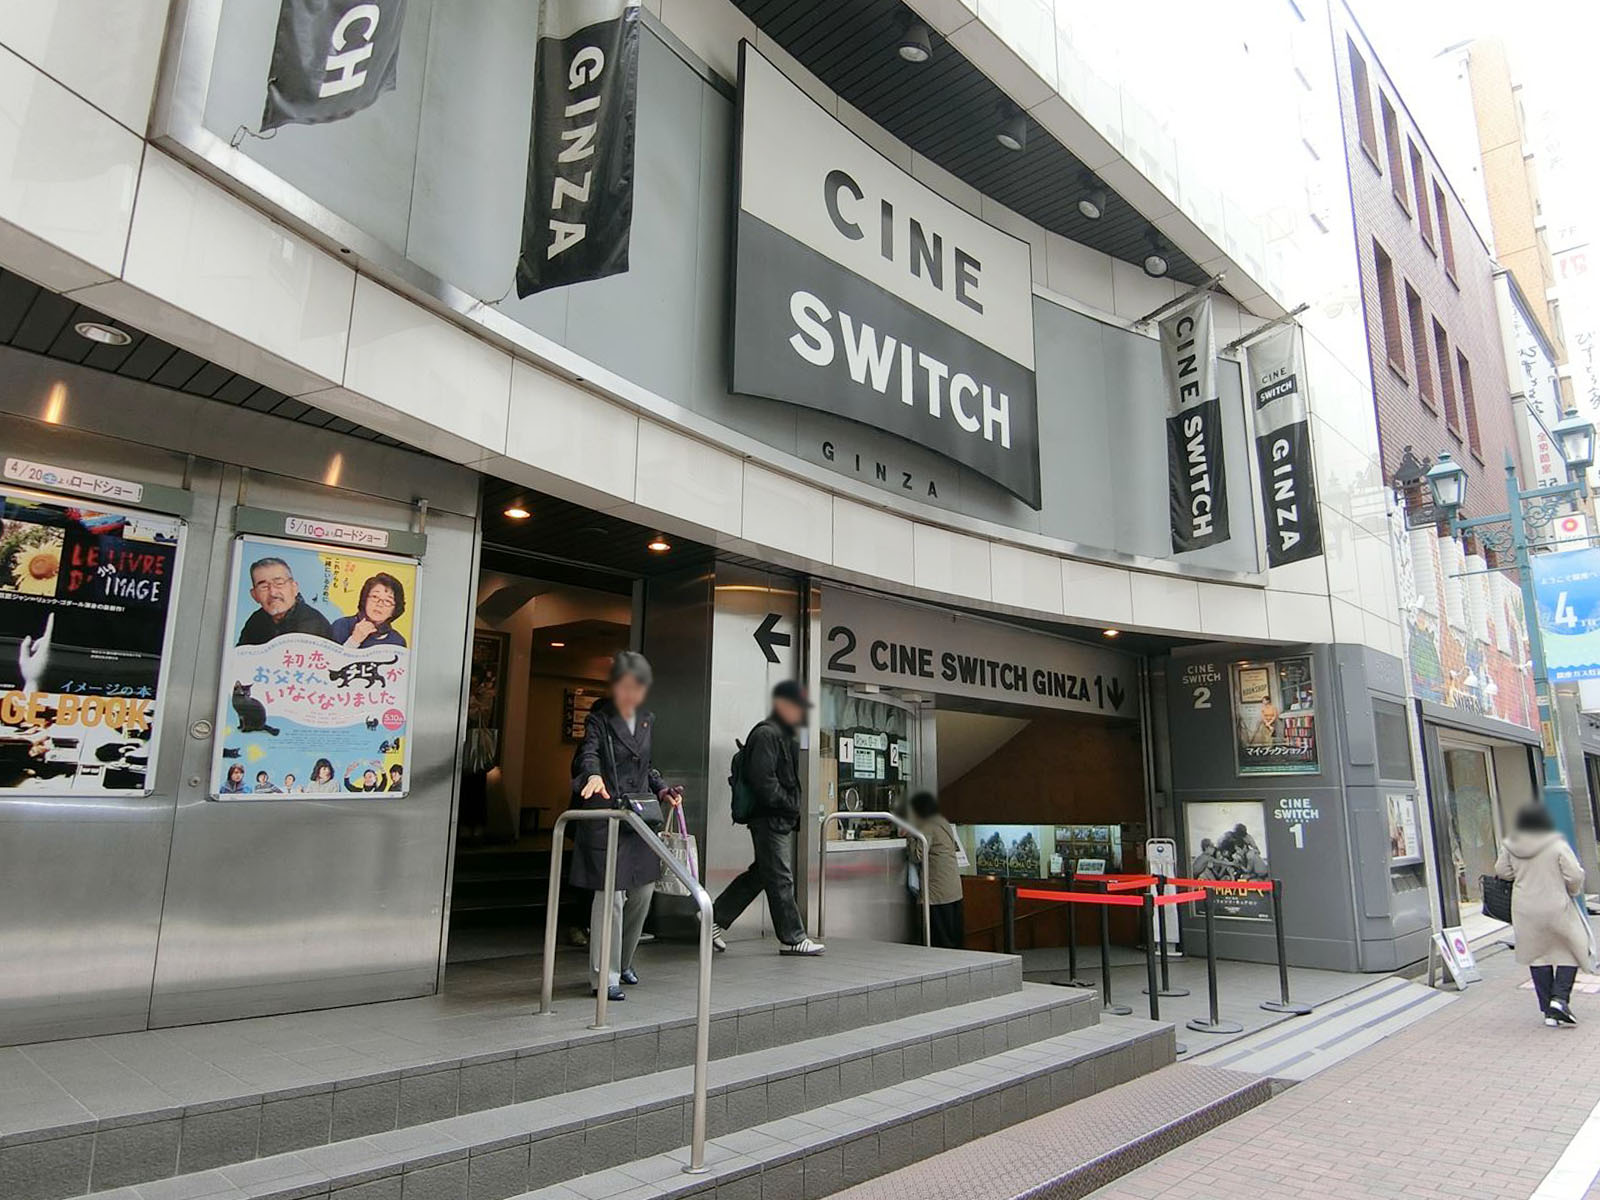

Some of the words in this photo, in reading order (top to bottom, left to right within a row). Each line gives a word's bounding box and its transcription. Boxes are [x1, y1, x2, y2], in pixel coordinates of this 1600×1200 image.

[547, 45, 605, 261] GINZA
[824, 168, 984, 316] CINE
[788, 290, 1011, 450] SWITCH
[1175, 316, 1200, 403] CINE
[1261, 367, 1288, 384] CINE
[1259, 380, 1293, 402] SWITCH
[822, 441, 938, 498] GINZA
[1183, 415, 1214, 539] SWITCH
[1271, 438, 1301, 551] GINZA
[71, 543, 99, 567] LE
[104, 576, 162, 602] IMAGE
[827, 625, 857, 674] 2
[870, 640, 935, 679] CINE
[941, 652, 1029, 693] SWITCH
[1032, 669, 1091, 702] GINZA
[1094, 674, 1105, 709] 1
[1182, 672, 1221, 685] SWITCH
[1187, 663, 1215, 674] CINE
[264, 685, 397, 710] いなくなりました
[1192, 687, 1212, 709] 2
[56, 694, 149, 731] BOOK
[843, 740, 849, 759] 1
[891, 746, 898, 764] 2
[1273, 808, 1320, 819] SWITCH
[1279, 798, 1312, 809] CINE
[1289, 823, 1304, 849] 1
